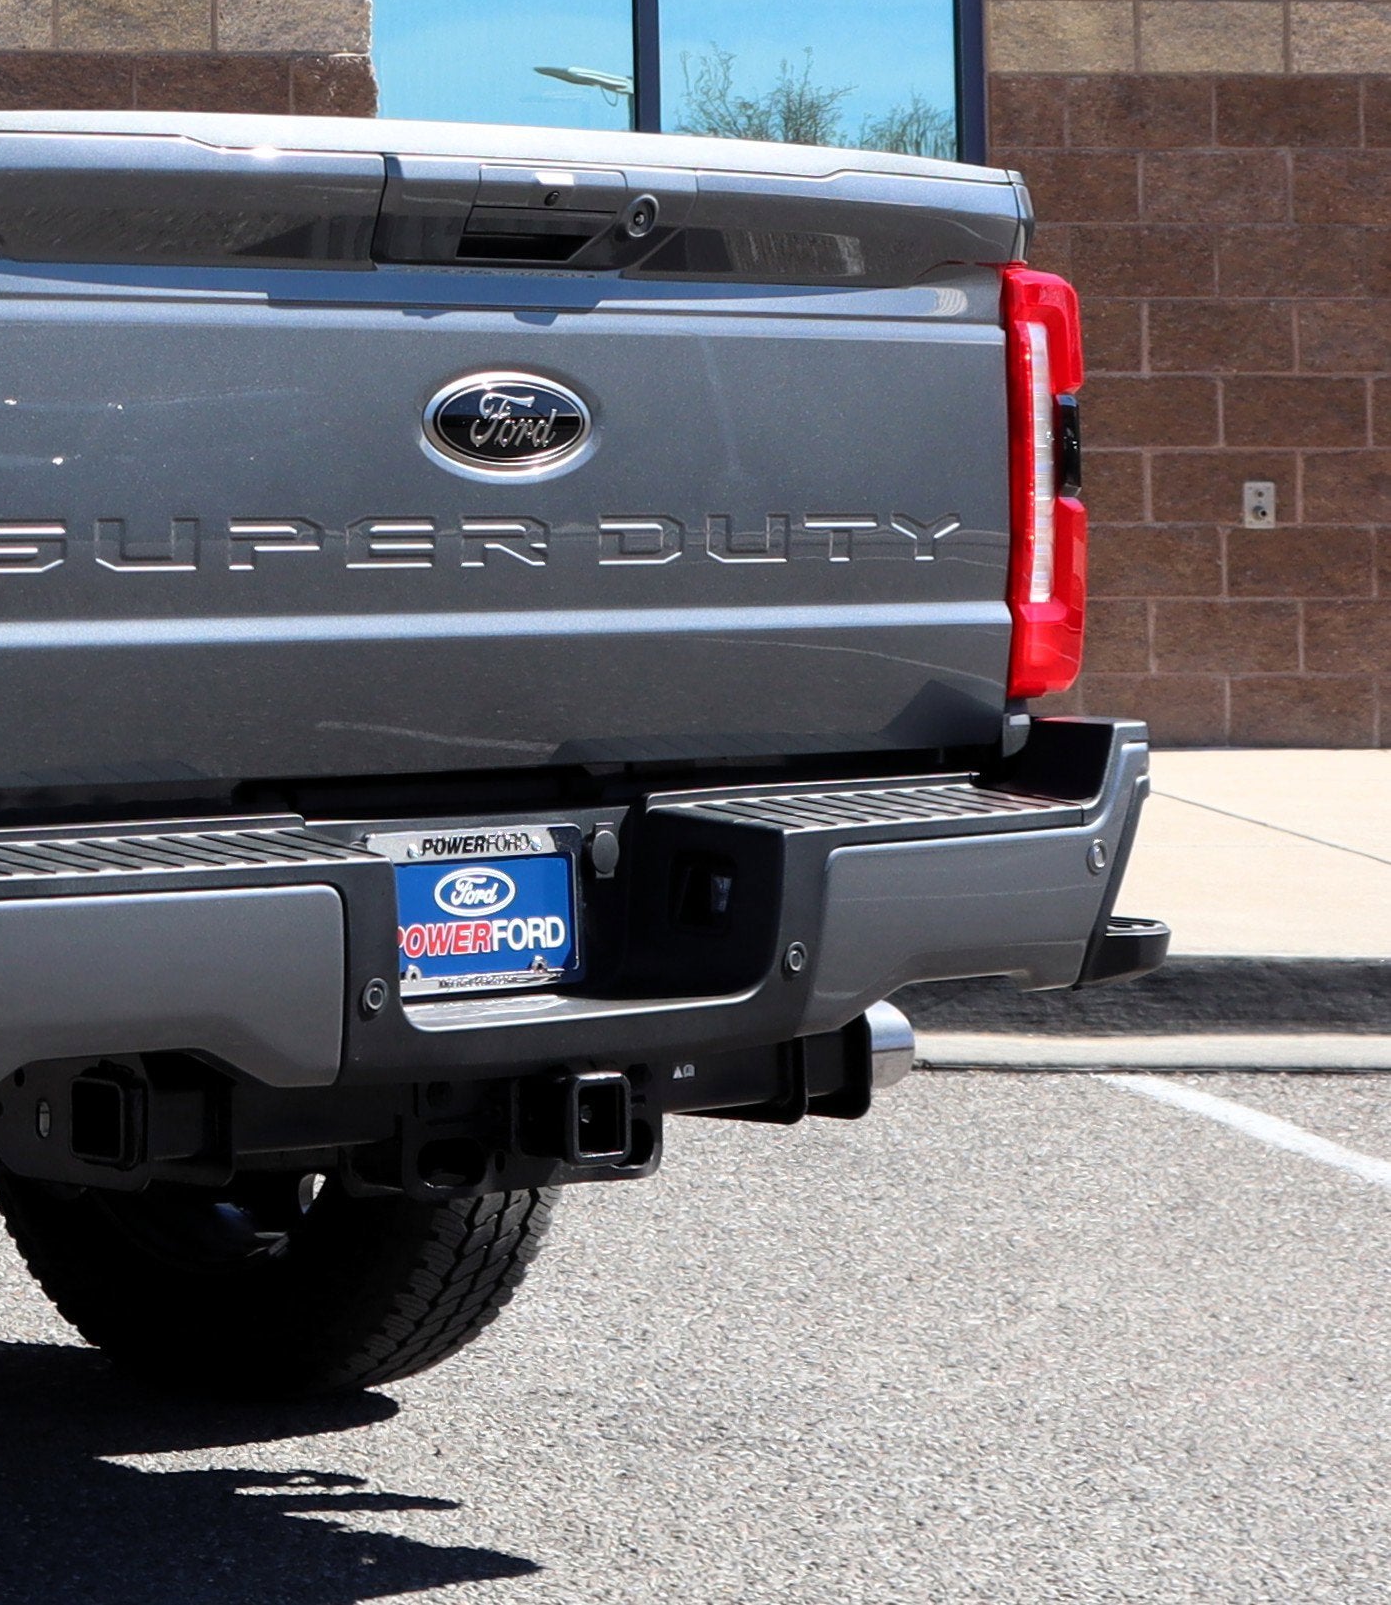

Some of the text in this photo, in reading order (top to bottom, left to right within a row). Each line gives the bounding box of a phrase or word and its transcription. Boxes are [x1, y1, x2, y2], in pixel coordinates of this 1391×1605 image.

[471, 390, 559, 448] Ford
[597, 511, 963, 568] DUTY
[420, 832, 530, 857] POWERFORD
[449, 876, 499, 907] Ford
